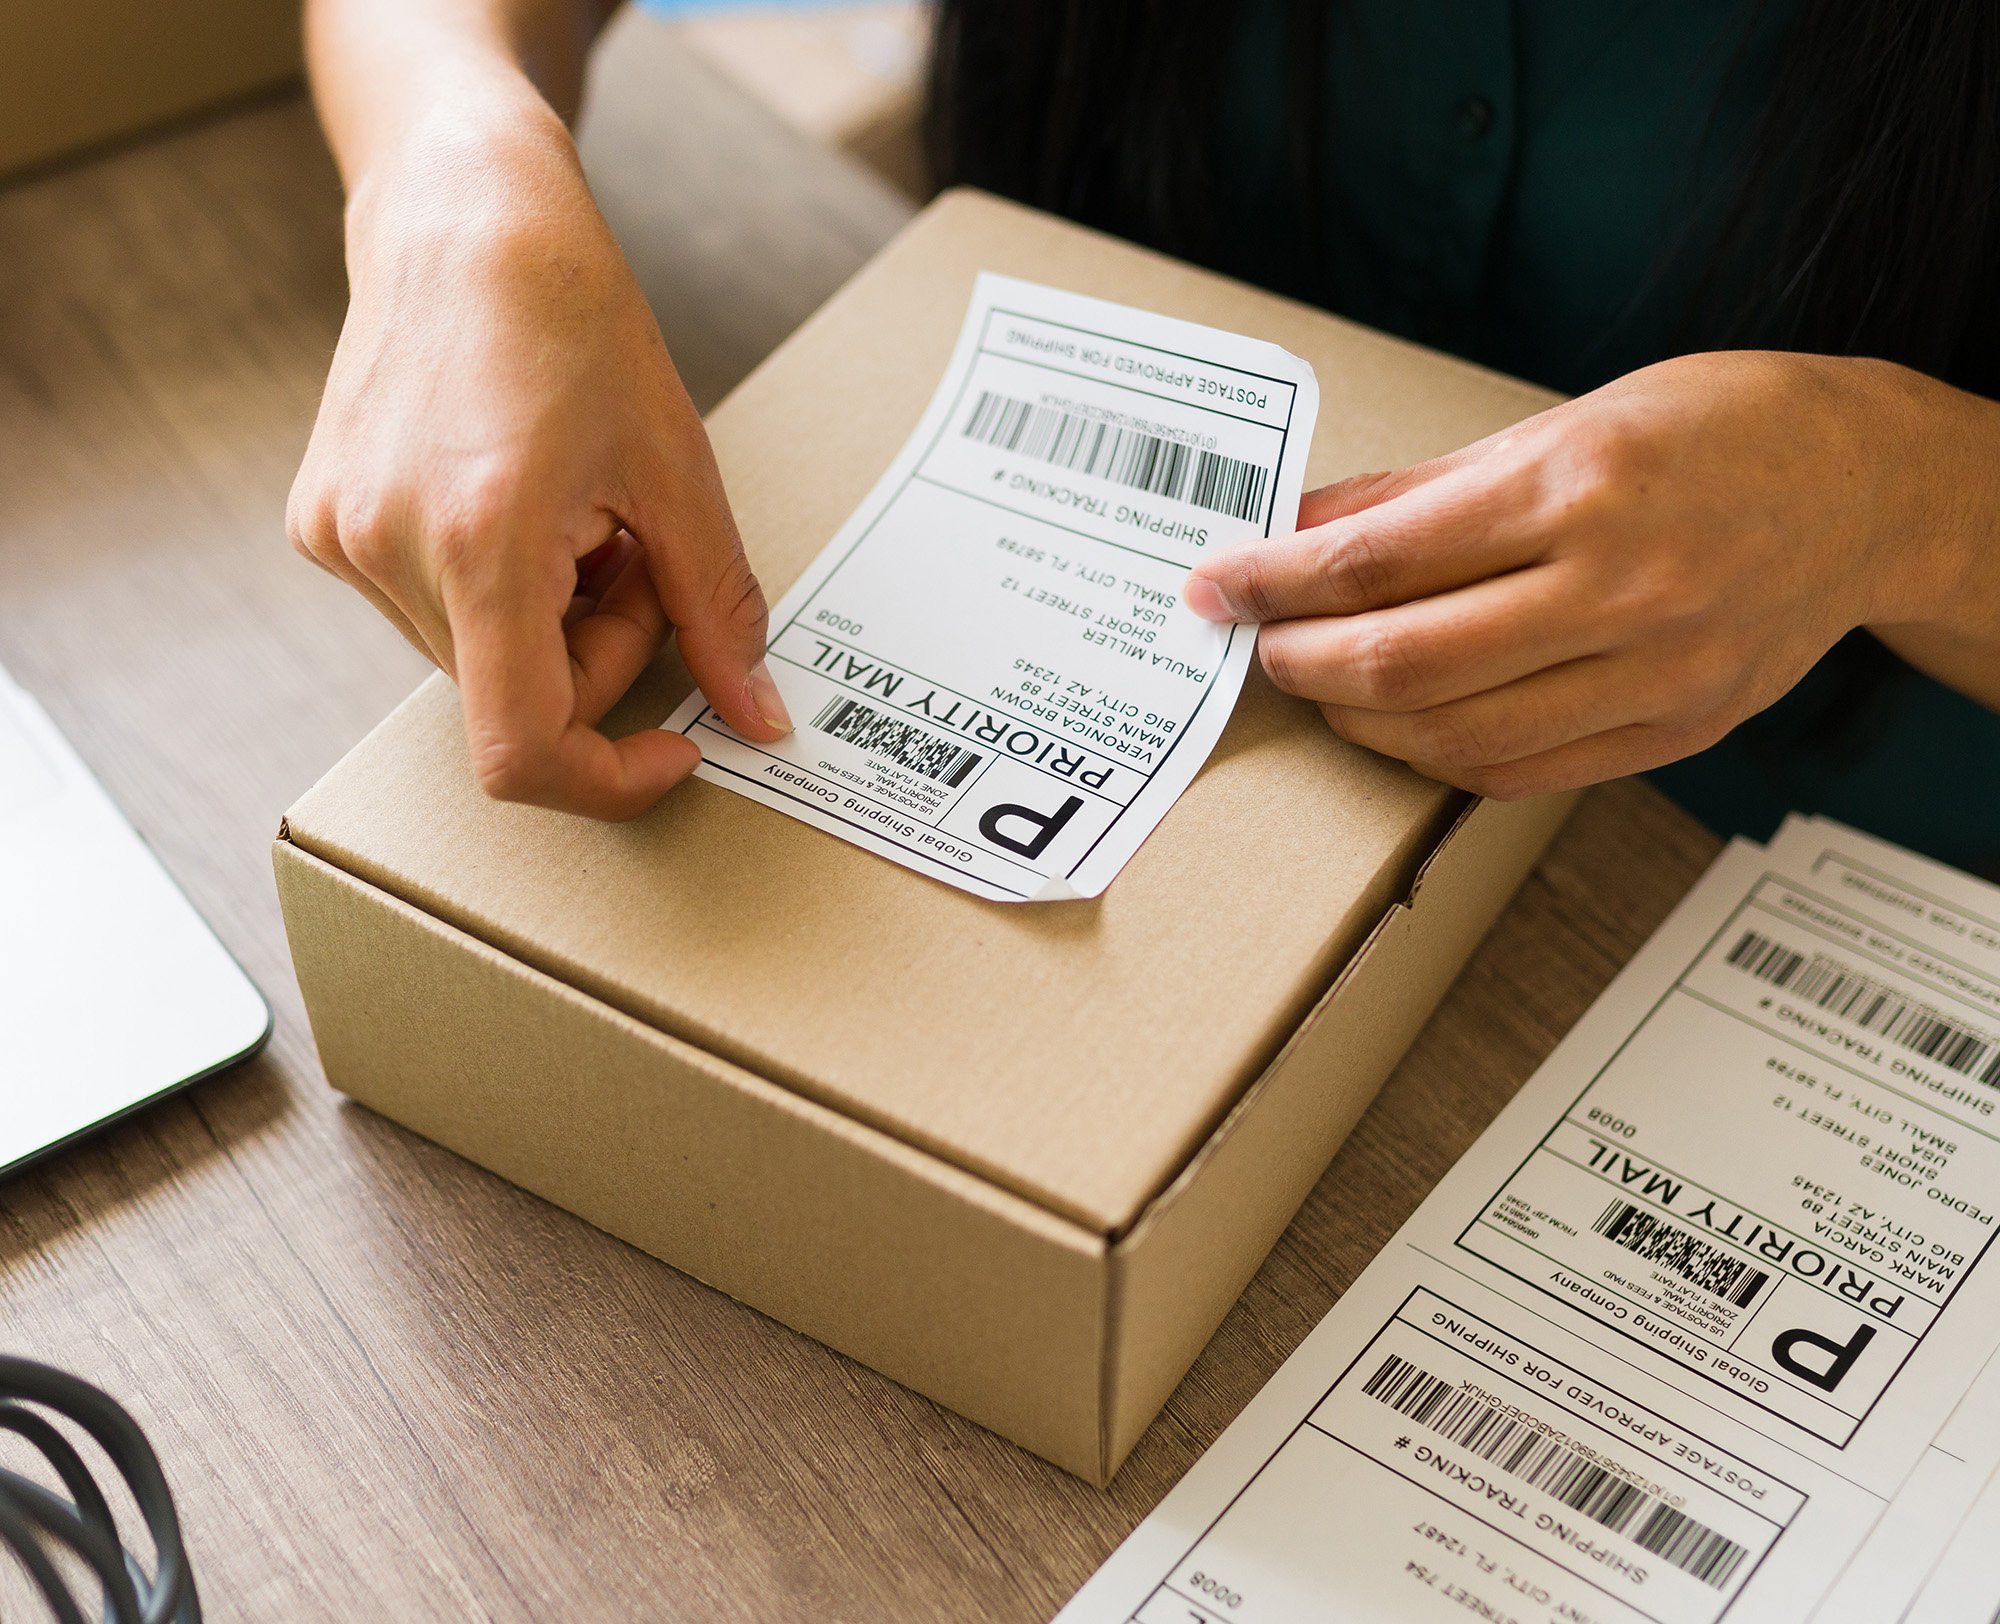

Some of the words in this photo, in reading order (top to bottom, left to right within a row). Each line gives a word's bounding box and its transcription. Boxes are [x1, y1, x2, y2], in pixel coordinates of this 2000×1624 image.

[1007, 330, 1074, 358] SHIPPING
[1081, 348, 1110, 368] FOR
[1114, 357, 1194, 388] APPROVED
[1198, 378, 1266, 408] POSTAGE
[991, 470, 1007, 482] #
[1010, 475, 1107, 517] TRACKING
[1115, 506, 1207, 546] SHIPPING
[1051, 556, 1070, 571] FL
[1000, 577, 1020, 591] 12
[1122, 580, 1176, 608] SMALL
[1023, 587, 1092, 620] STREET
[1132, 605, 1166, 627] USA
[816, 609, 863, 636] 0008
[1095, 614, 1156, 643] SHORT
[1082, 628, 1146, 660] MILLER
[813, 641, 903, 698] MAIL
[1013, 658, 1061, 685] 12345
[1152, 654, 1207, 682] PAULA
[1020, 681, 1041, 695] 89
[1067, 681, 1092, 697] AZ
[990, 687, 1058, 722] BROWN
[1044, 692, 1115, 726] STREET
[1097, 691, 1139, 717] CITY,
[1119, 723, 1165, 748] MAIN
[1144, 713, 1176, 733] BIG
[906, 691, 1114, 789] PRIORITY
[1063, 716, 1152, 764] VERONICA
[818, 760, 840, 775] PAID
[841, 771, 866, 786] FEES
[864, 759, 890, 774] RATE
[876, 774, 896, 787] MAIL
[890, 770, 914, 785] FLAT
[764, 764, 839, 802] Company
[866, 781, 874, 789] &
[892, 782, 941, 807] PRIORITY
[922, 783, 948, 799] ZONE
[873, 785, 919, 810] POSTAGE
[920, 805, 934, 815] US
[843, 798, 914, 836] Shipping
[978, 796, 1084, 860] P
[917, 833, 972, 862] Global
[1777, 1005, 1884, 1066] TRACKING
[1823, 1083, 1842, 1101] FL
[1890, 1059, 1995, 1116] SHIPPING
[1772, 1096, 1793, 1111] 12
[1588, 1107, 1636, 1138] 0008
[1796, 1108, 1870, 1148] STREET
[1900, 1121, 1957, 1154] SMALL
[1873, 1144, 1938, 1180] SHORT
[1911, 1143, 1947, 1167] USA
[1588, 1139, 1682, 1205] MAIL
[1860, 1154, 1922, 1190] JONES
[1791, 1175, 1842, 1205] 12345
[1532, 1211, 1549, 1222] ZIP
[1801, 1199, 1823, 1214] 89
[1848, 1203, 1875, 1220] AZ
[1927, 1188, 1993, 1225] PEDRO
[1548, 1218, 1578, 1237] FROM
[1826, 1212, 1901, 1252] STREET
[1881, 1216, 1925, 1246] CITY,
[1813, 1222, 1884, 1263] GARCIA
[1931, 1243, 1964, 1266] BIG
[1687, 1201, 1905, 1318] PRIORITY
[1906, 1250, 1954, 1279] MAIN
[1603, 1270, 1627, 1287] PAID
[1650, 1272, 1676, 1289] RATE
[1888, 1260, 1944, 1294] MARK
[1549, 1272, 1628, 1319] Company
[1627, 1282, 1653, 1302] FEES
[1653, 1296, 1662, 1305] &
[1662, 1288, 1685, 1304] MAIL
[1676, 1285, 1701, 1302] FLAT
[1661, 1302, 1708, 1331] POSTAGE
[1683, 1301, 1731, 1328] PRIORITY
[1710, 1302, 1738, 1320] ZONE
[1431, 1312, 1519, 1366] SHIPPING
[1632, 1314, 1708, 1361] Shipping
[1709, 1326, 1724, 1337] US
[1771, 1324, 1877, 1393] P
[1522, 1362, 1563, 1388] FOR
[1711, 1358, 1769, 1393] Global
[1566, 1384, 1672, 1446] APPROVED
[1393, 1435, 1411, 1449] #
[1414, 1445, 1529, 1519] TRACKING
[1672, 1442, 1767, 1500] POSTAGE
[1412, 1521, 1467, 1557] 12487
[1534, 1513, 1648, 1586] SHIPPING
[1404, 1560, 1438, 1586] 754
[1476, 1552, 1498, 1574] FL
[1188, 1571, 1243, 1610] 0008
